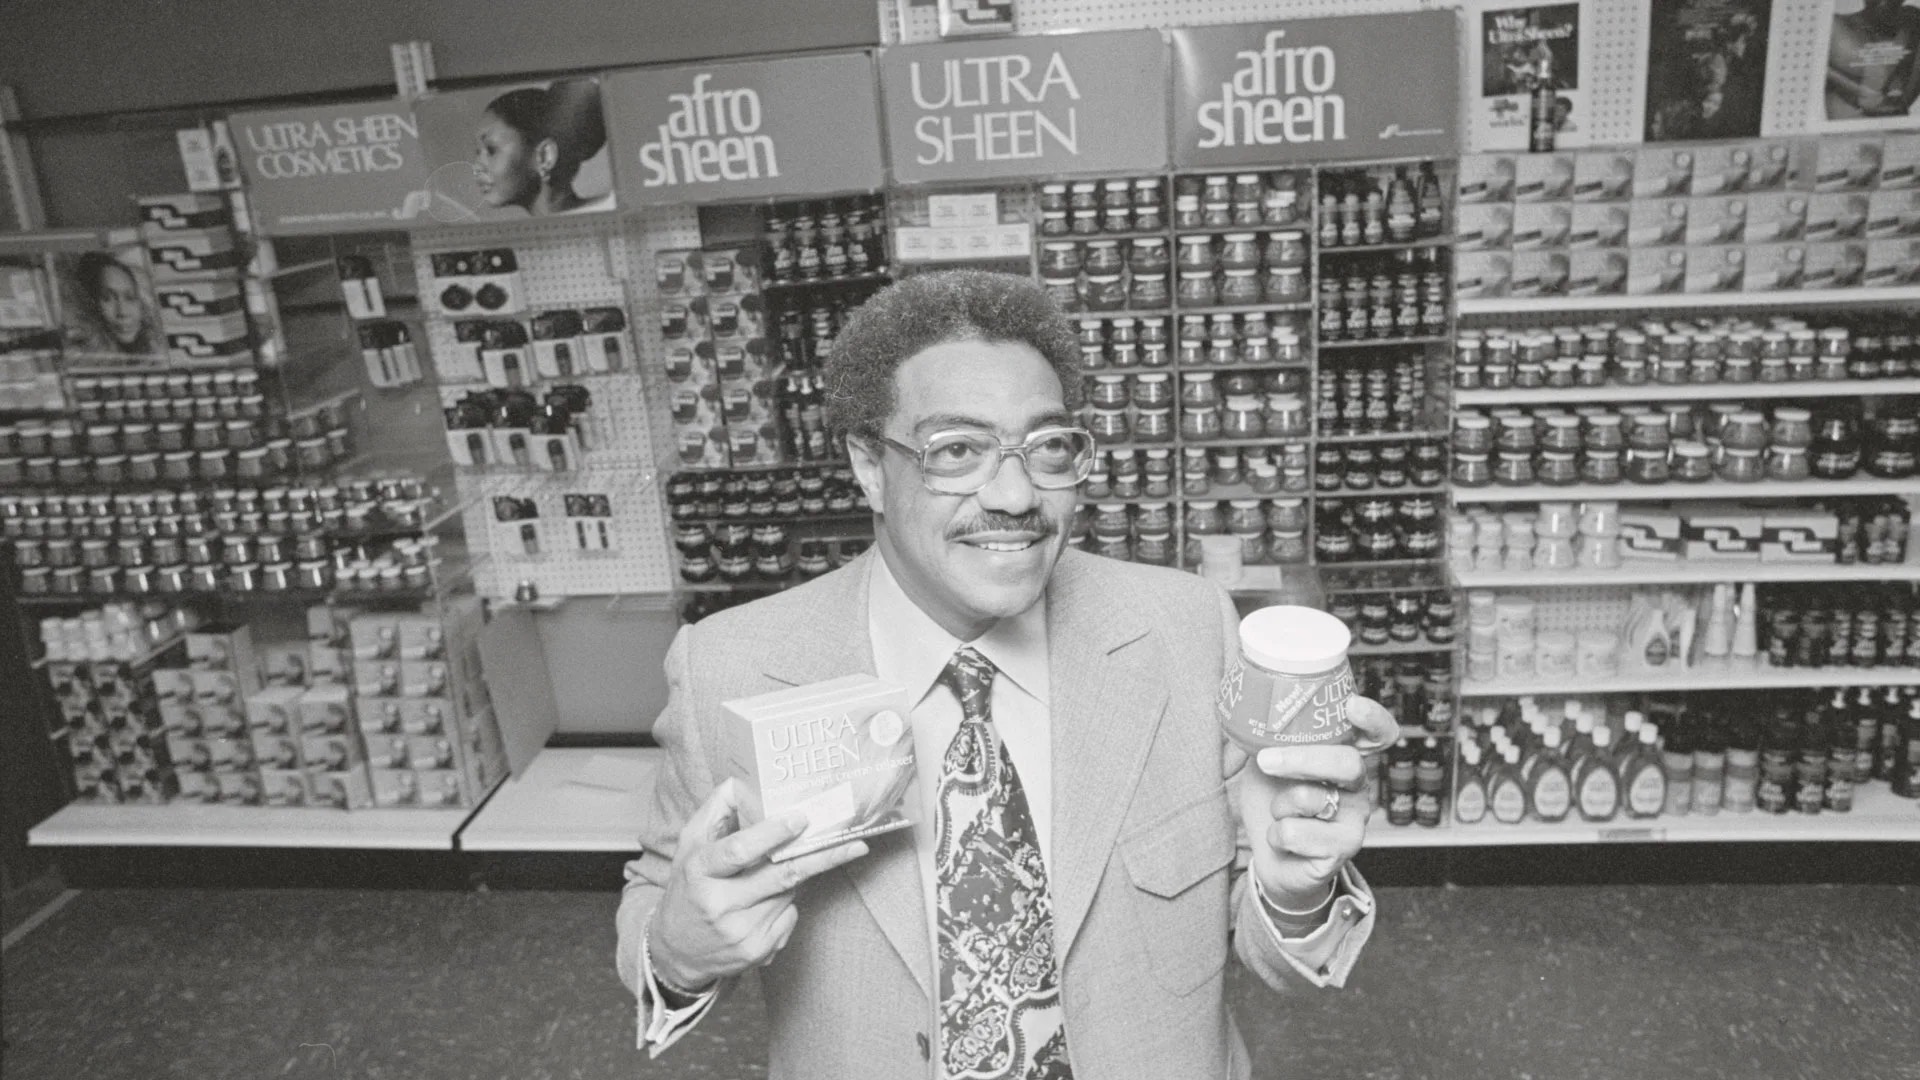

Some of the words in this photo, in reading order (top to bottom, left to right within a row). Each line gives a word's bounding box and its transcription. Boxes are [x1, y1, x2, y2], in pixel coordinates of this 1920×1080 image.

[910, 51, 1081, 110] ULTRA
[1232, 29, 1337, 97] afro
[246, 119, 332, 153] ULTRA
[333, 111, 419, 144] SHEEN
[667, 73, 761, 138] afro
[1197, 82, 1348, 148] sheen
[256, 143, 404, 180] COSMETICS
[639, 124, 782, 188] sheen
[914, 107, 1080, 165] SHEEN
[768, 713, 858, 752] ULTRA
[773, 736, 861, 782] SHEEN
[1273, 729, 1334, 743] conditioner
[1335, 725, 1342, 737] &
